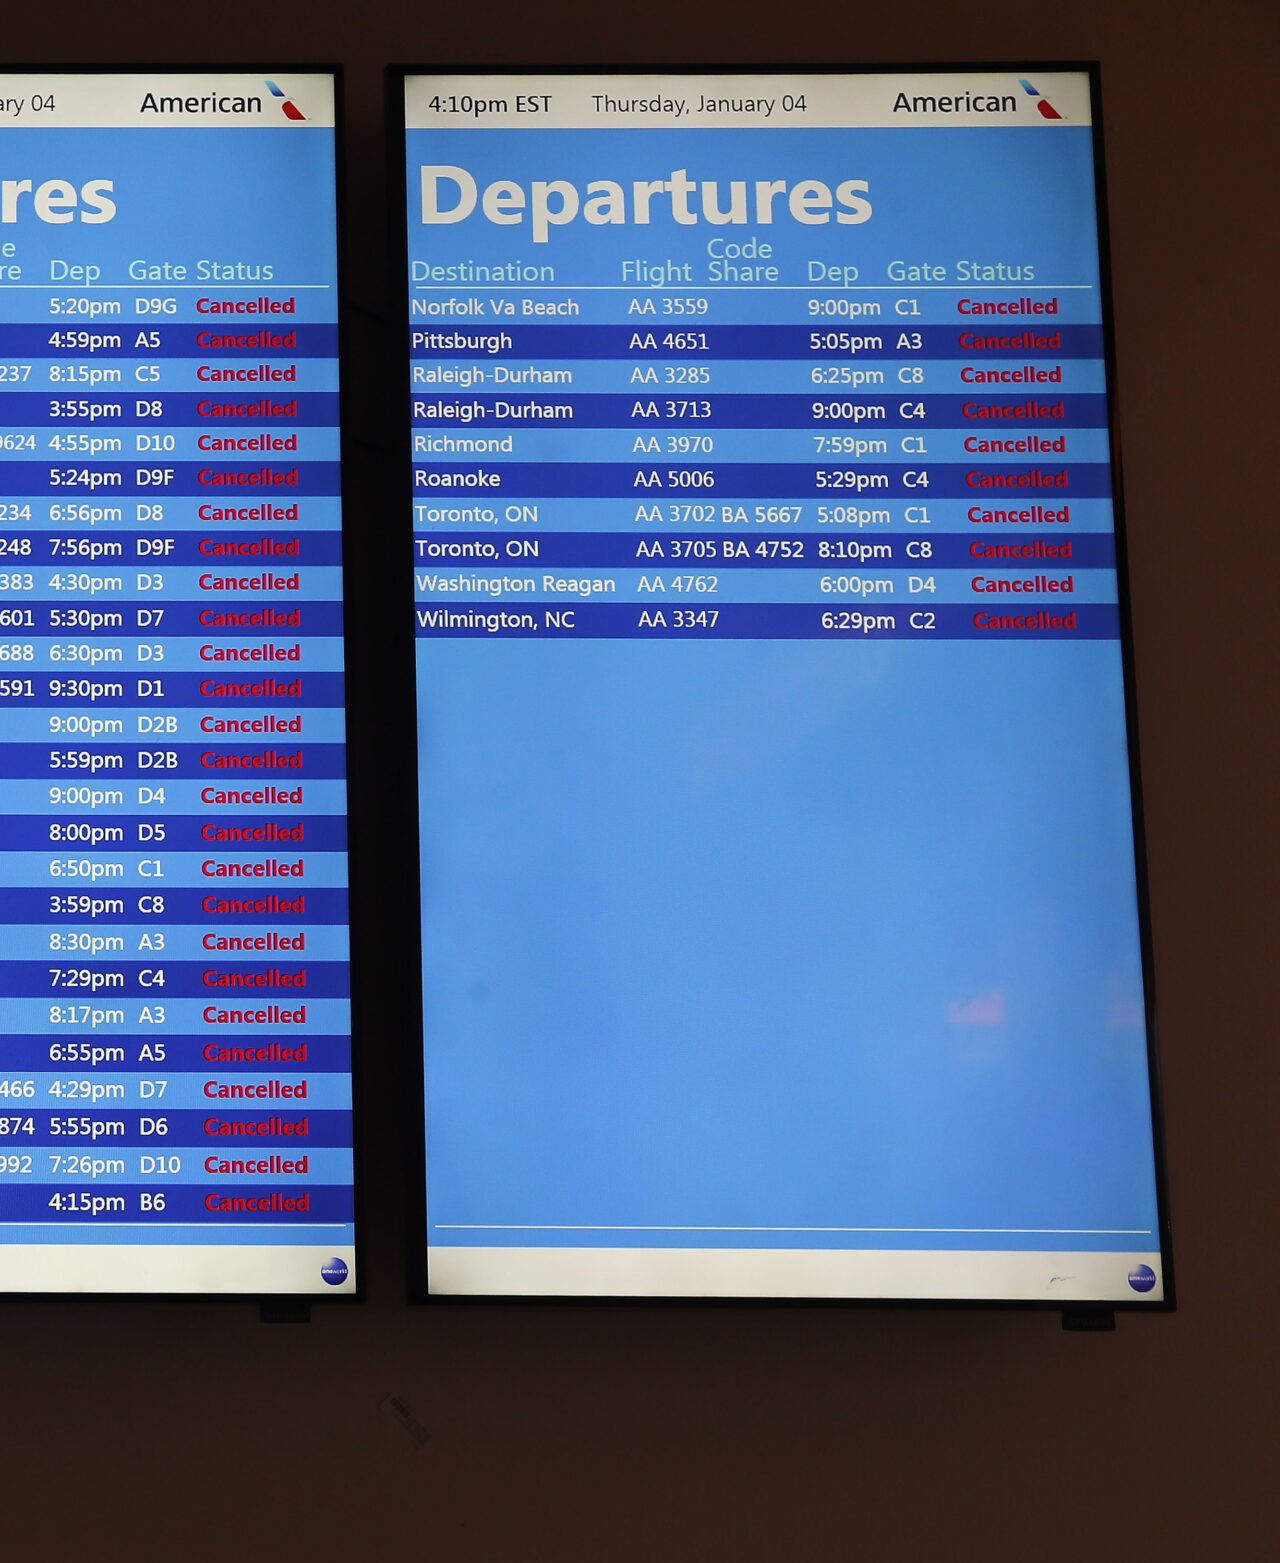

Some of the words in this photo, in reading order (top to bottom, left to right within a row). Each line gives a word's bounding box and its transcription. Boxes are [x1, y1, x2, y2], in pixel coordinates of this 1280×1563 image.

[32, 95, 55, 111] 04
[140, 92, 261, 113] American
[429, 96, 507, 117] 4:10pm
[517, 96, 552, 112] EST
[592, 95, 689, 117] Thursday,
[697, 96, 775, 117] January
[783, 95, 807, 111] 04
[893, 91, 1016, 112] American
[421, 166, 872, 243] Departures
[708, 237, 772, 258] Code
[51, 260, 100, 284] Dep
[129, 260, 186, 280] Gate
[197, 260, 273, 280] Status
[412, 260, 554, 281] Destination
[622, 260, 692, 285] Flight
[709, 260, 778, 281] Share
[808, 261, 858, 285] Dep
[888, 261, 946, 281] Gate
[957, 261, 1034, 280] Status
[50, 298, 120, 318] 5:20pm
[136, 298, 176, 314] D9G
[198, 298, 296, 314] Cancelled
[412, 298, 485, 315] Norfolk
[490, 299, 515, 315] Va
[523, 299, 579, 315] Beach
[628, 299, 656, 314] AA
[663, 299, 708, 314] 3559
[808, 300, 880, 319] 9:00pm
[895, 299, 920, 315] C1
[959, 298, 1058, 315] Cancelled
[414, 401, 572, 422] Raleigh-Durham
[632, 401, 659, 417] AA
[666, 401, 711, 417] 3713
[813, 403, 885, 423] 9:00pm
[900, 403, 925, 418] C4
[964, 402, 1064, 418] Cancelled
[49, 539, 121, 560] 7:56pm
[138, 539, 174, 555] D9F
[200, 539, 299, 555] Cancelled
[415, 540, 499, 559] Toronto,
[506, 541, 538, 556] ON
[636, 541, 664, 557] AA
[671, 541, 716, 557] 3705
[724, 541, 750, 557] BA
[755, 542, 803, 557] 4752
[819, 542, 891, 562] 8:10pm
[906, 542, 932, 558] C8
[971, 542, 1072, 557] Cancelled
[417, 610, 537, 632] Wilmington,
[546, 611, 574, 627] NC
[638, 611, 666, 627] AA
[674, 611, 719, 627] 3347
[822, 613, 895, 633] 6:29pm
[910, 613, 935, 629] C2
[974, 612, 1076, 628] Cancelled
[50, 716, 122, 737] 9:00pm
[138, 716, 177, 732] D2B
[202, 716, 302, 733] Cancelled
[50, 824, 123, 845] 8:00pm
[139, 824, 165, 841] D5
[202, 824, 304, 840] Cancelled
[50, 1006, 124, 1028] 8:17pm
[139, 1007, 165, 1023] A3
[204, 1006, 307, 1024] Cancelled
[49, 1156, 124, 1178] 7:26pm
[141, 1156, 180, 1173] D10
[206, 1156, 309, 1174] Cancelled
